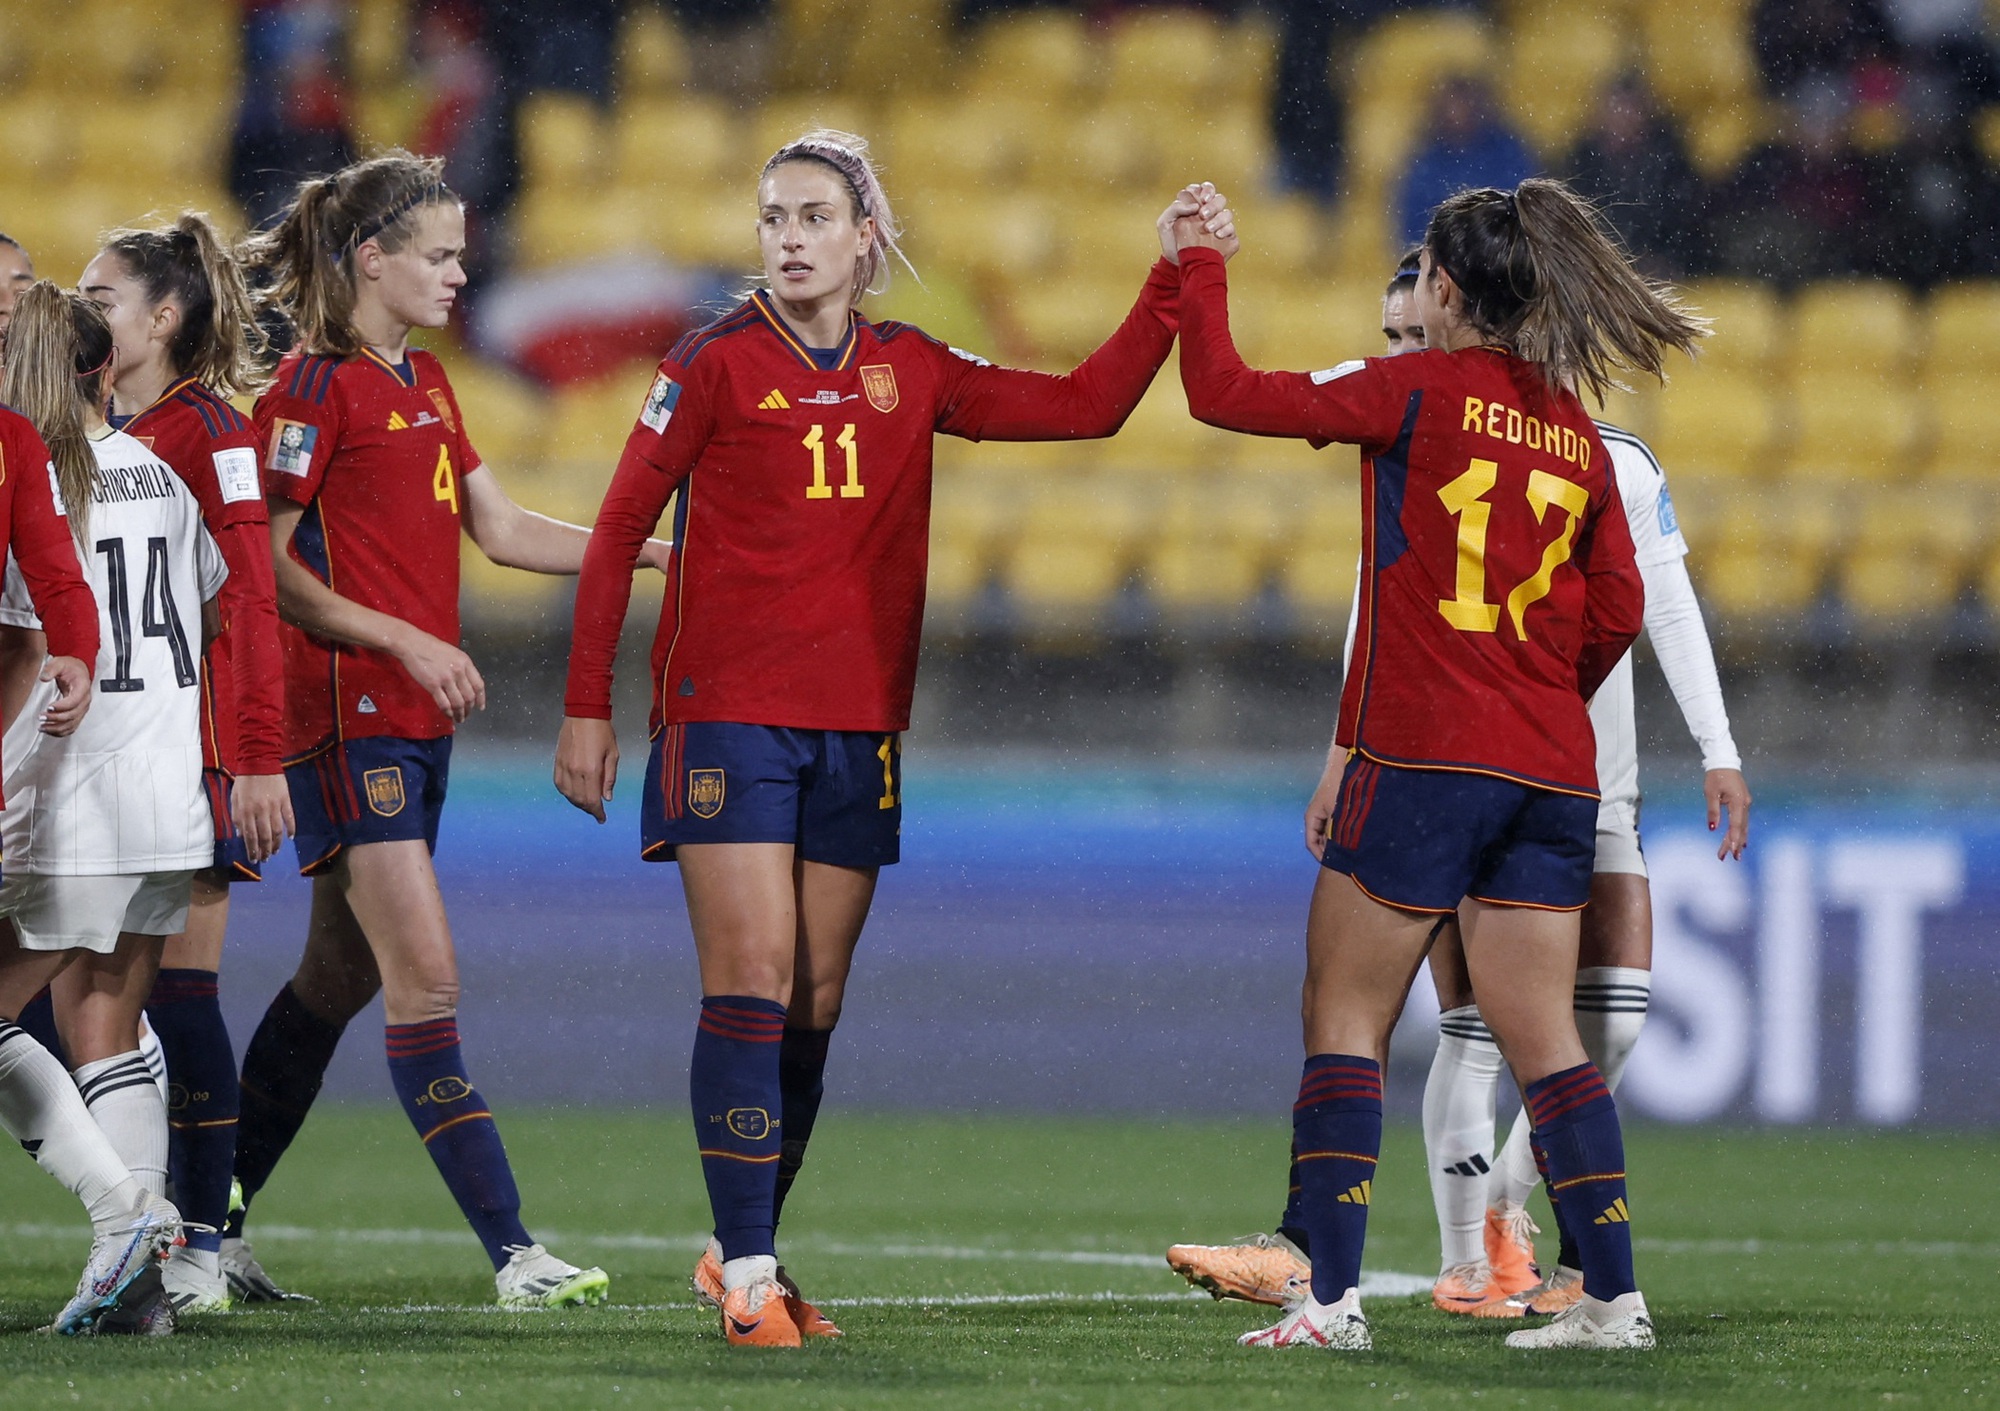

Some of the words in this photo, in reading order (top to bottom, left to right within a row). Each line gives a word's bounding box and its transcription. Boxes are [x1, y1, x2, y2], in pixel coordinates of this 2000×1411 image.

[801, 423, 865, 499] 11
[1462, 396, 1591, 472] REDONDO
[433, 443, 458, 514] 4
[1436, 457, 1589, 642] 17
[96, 536, 197, 693] 14
